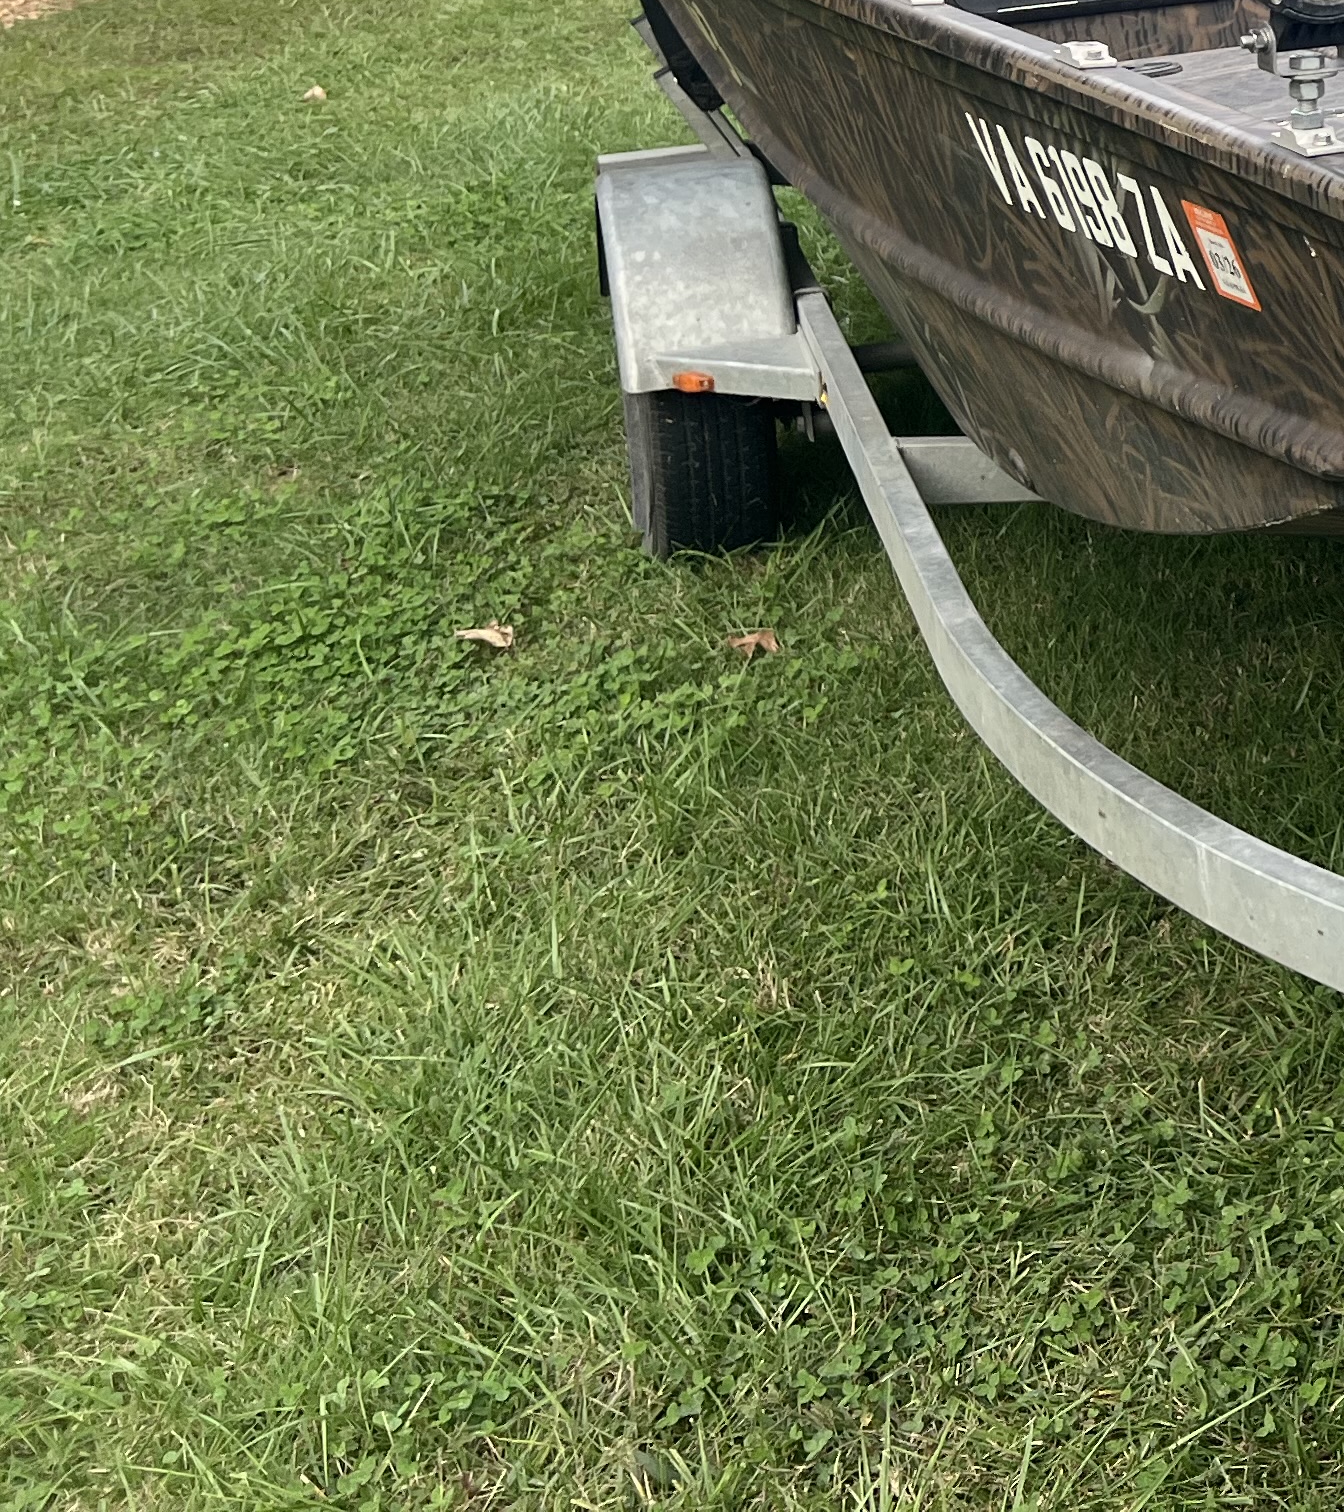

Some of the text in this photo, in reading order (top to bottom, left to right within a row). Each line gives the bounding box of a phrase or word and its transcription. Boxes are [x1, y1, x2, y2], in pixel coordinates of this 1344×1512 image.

[964, 112, 1206, 291] VA 6198 ZA
